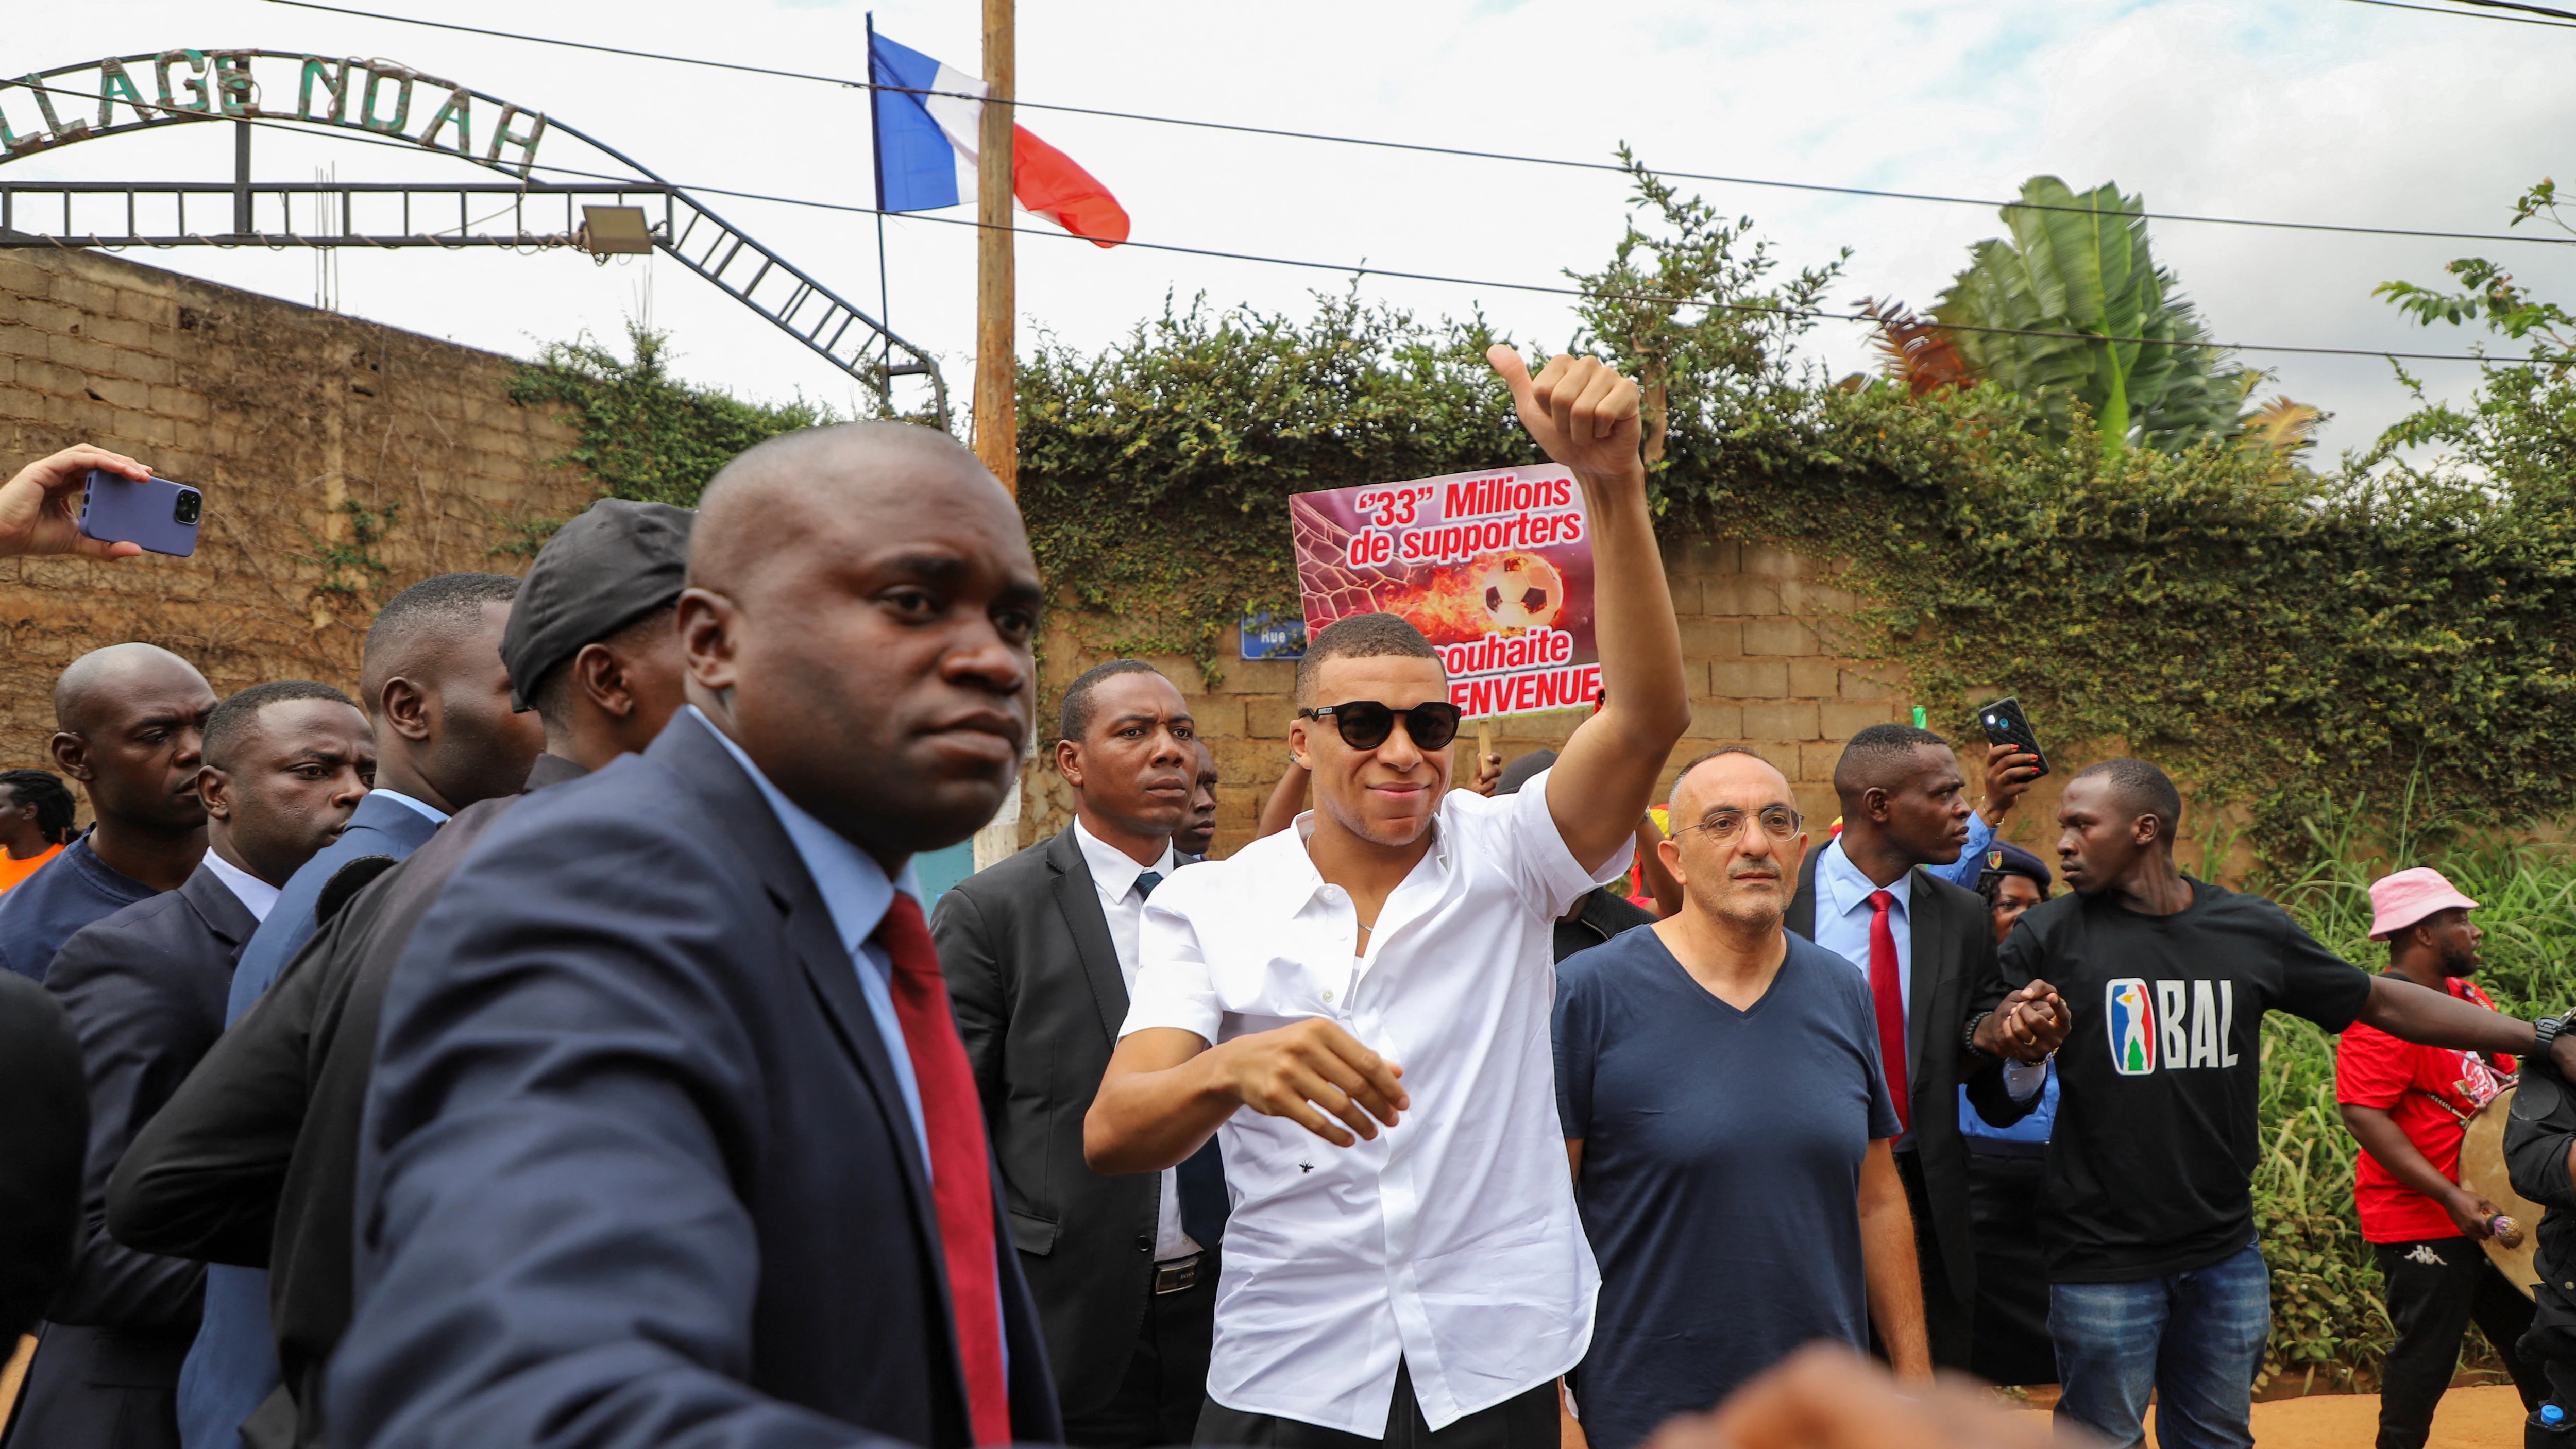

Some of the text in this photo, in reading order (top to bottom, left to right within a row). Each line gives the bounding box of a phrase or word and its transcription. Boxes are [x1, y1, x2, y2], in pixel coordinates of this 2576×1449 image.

[297, 53, 546, 178] NOAH
[1444, 476, 1572, 518] Millions
[1350, 512, 1581, 566] de supporters
[1261, 629, 1286, 644] Rue
[1436, 628, 1569, 674] ouhaite
[1447, 667, 1600, 717] ENVENUE
[2155, 979, 2239, 1069] BAL
